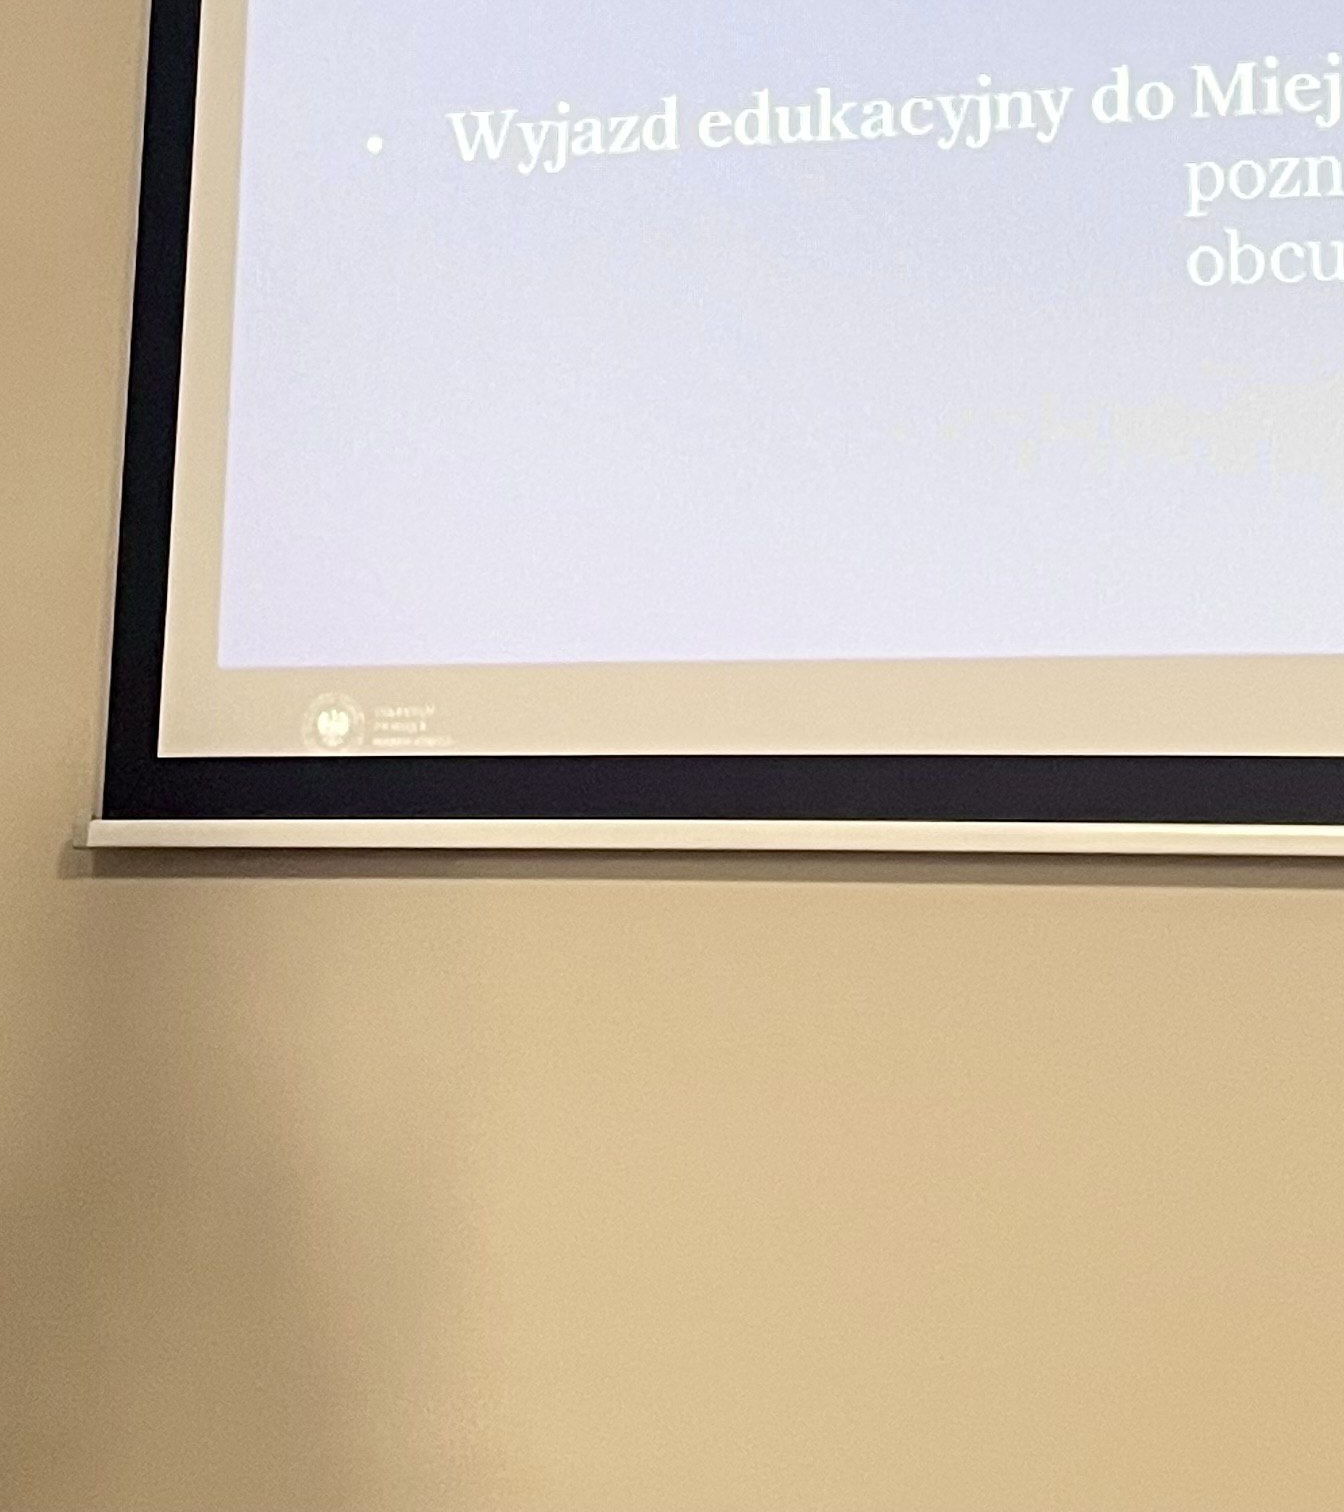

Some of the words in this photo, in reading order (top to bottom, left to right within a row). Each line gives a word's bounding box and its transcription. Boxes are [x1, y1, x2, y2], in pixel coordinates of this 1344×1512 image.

[445, 94, 680, 176] Wyjazd
[698, 73, 1074, 150] edukacyjny
[1091, 64, 1175, 124] do
